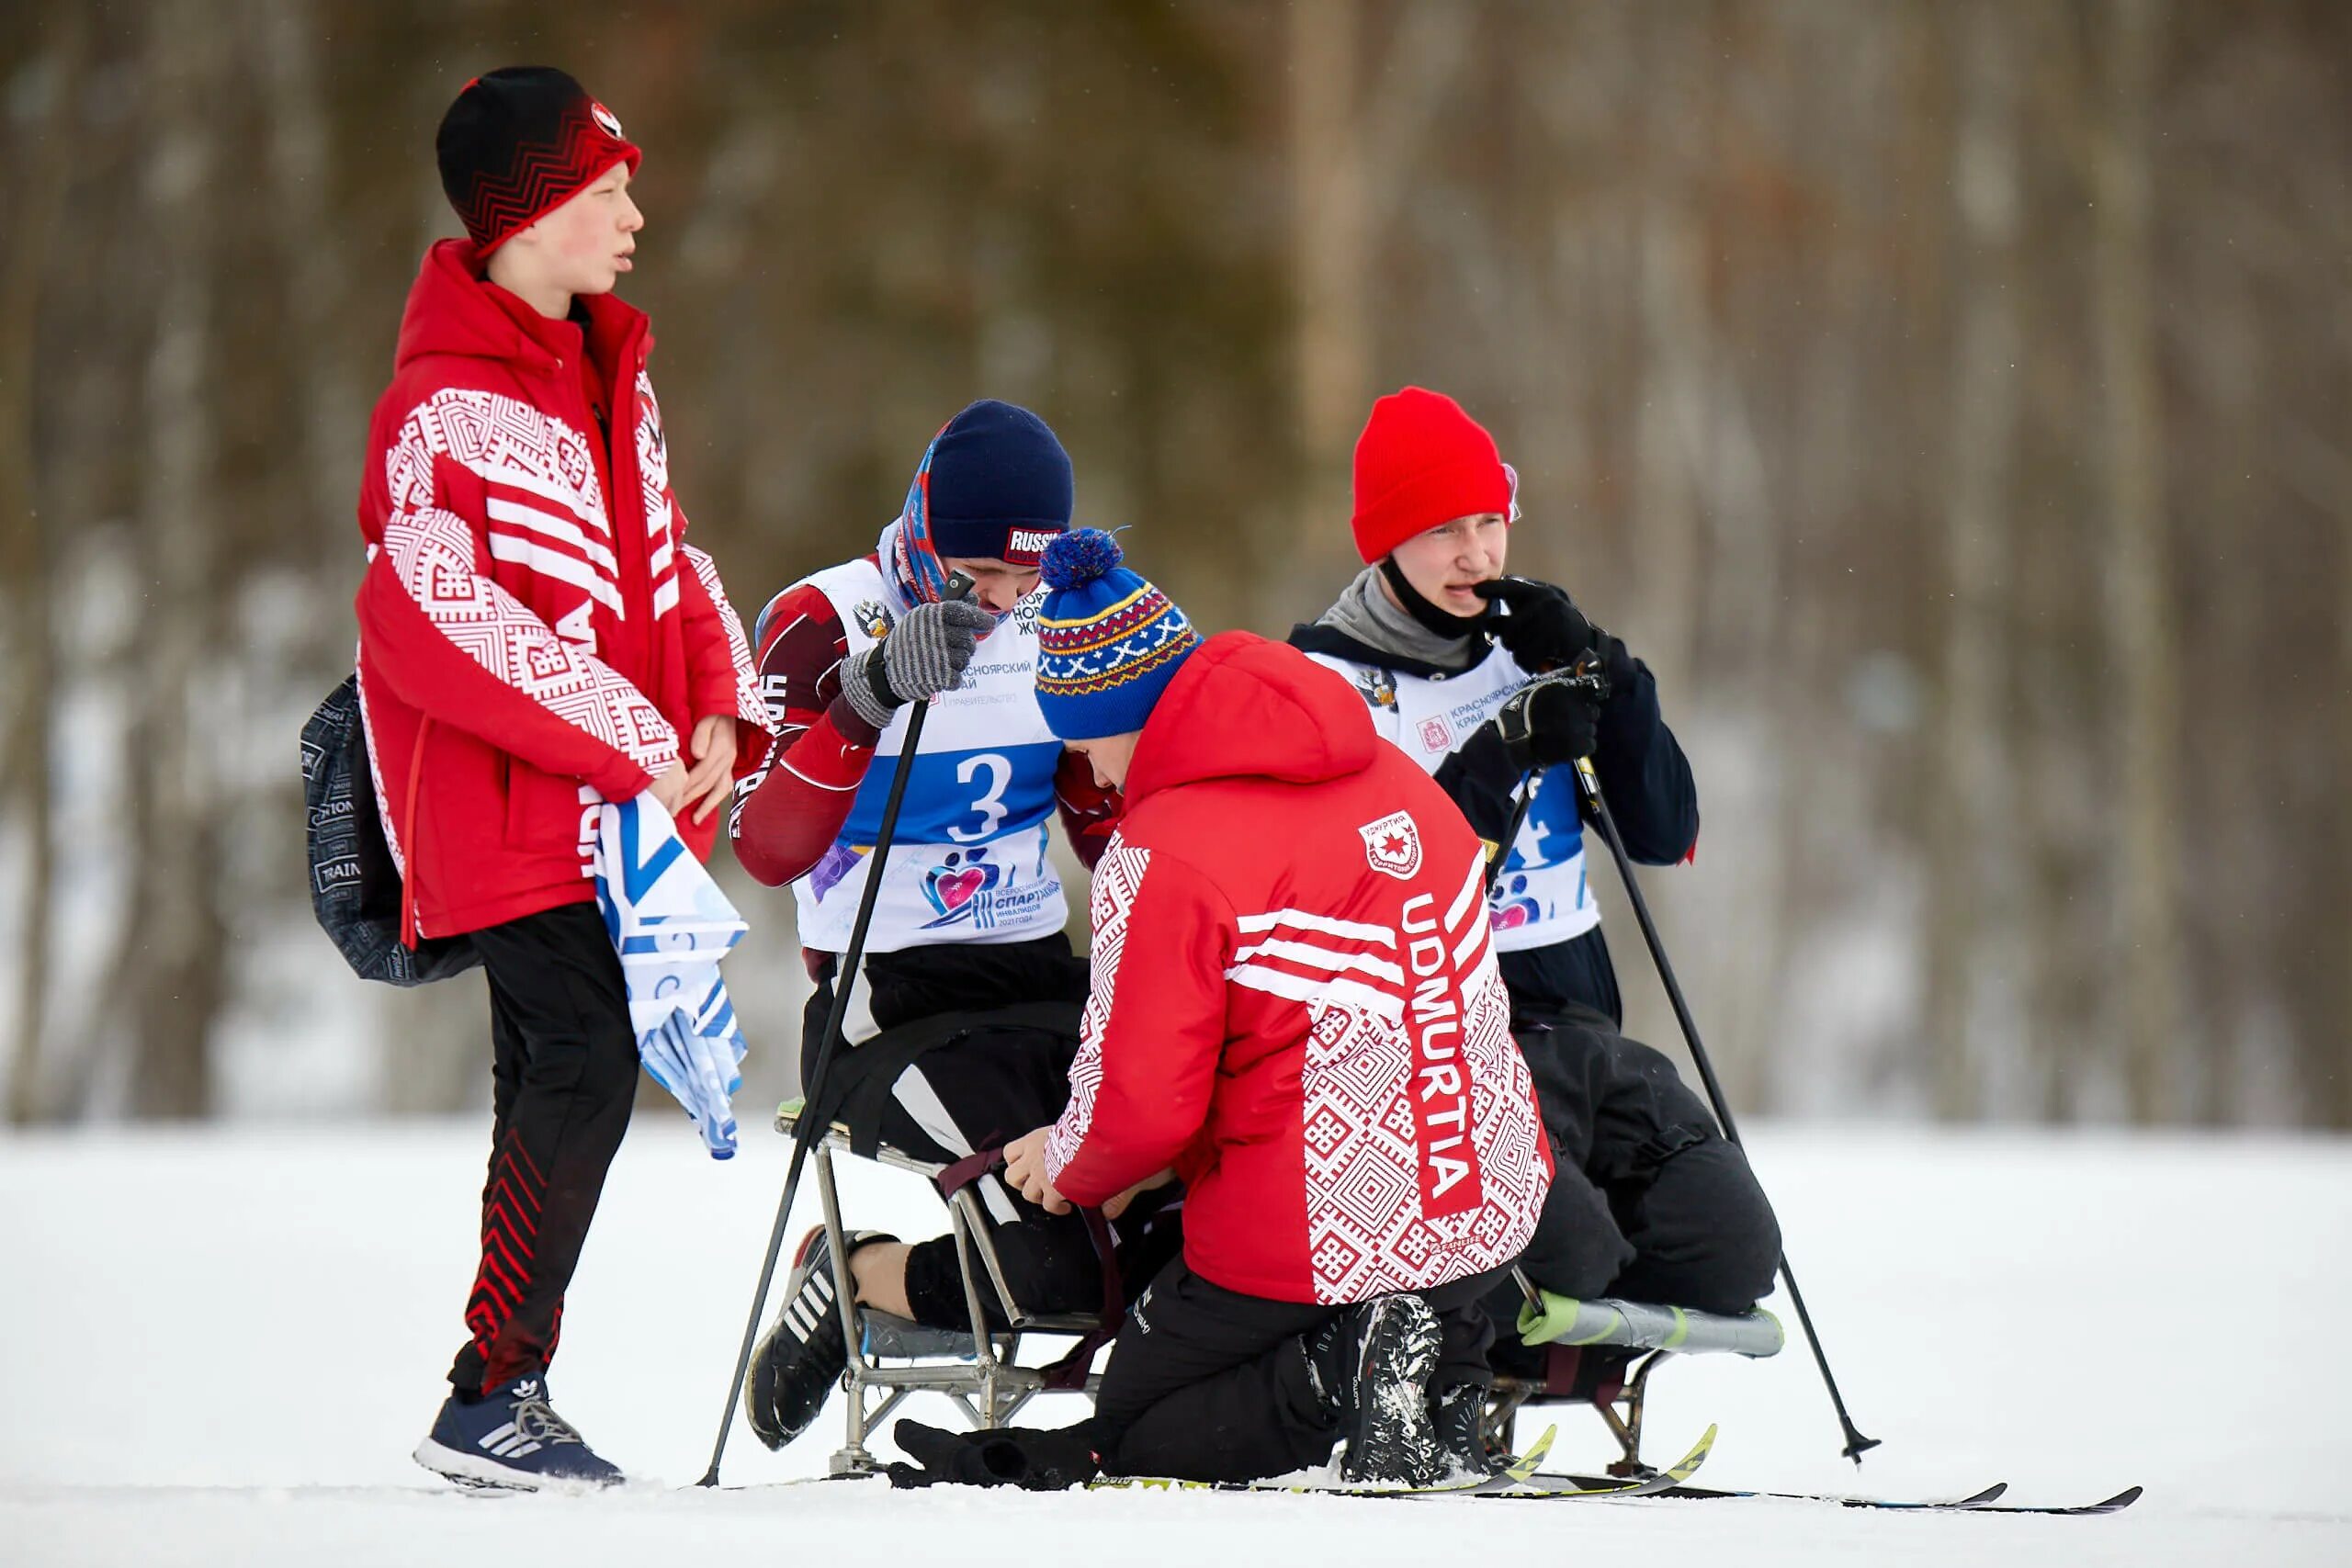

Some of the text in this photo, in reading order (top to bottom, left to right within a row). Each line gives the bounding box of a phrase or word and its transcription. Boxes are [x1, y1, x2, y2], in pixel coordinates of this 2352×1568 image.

[1455, 710, 1486, 730] КРАЙ
[946, 753, 1012, 842] 3
[996, 903, 1041, 918] ИНВАЛИДОВ
[999, 918, 1014, 927] 2021
[1402, 893, 1470, 1200] UDMURTIA
